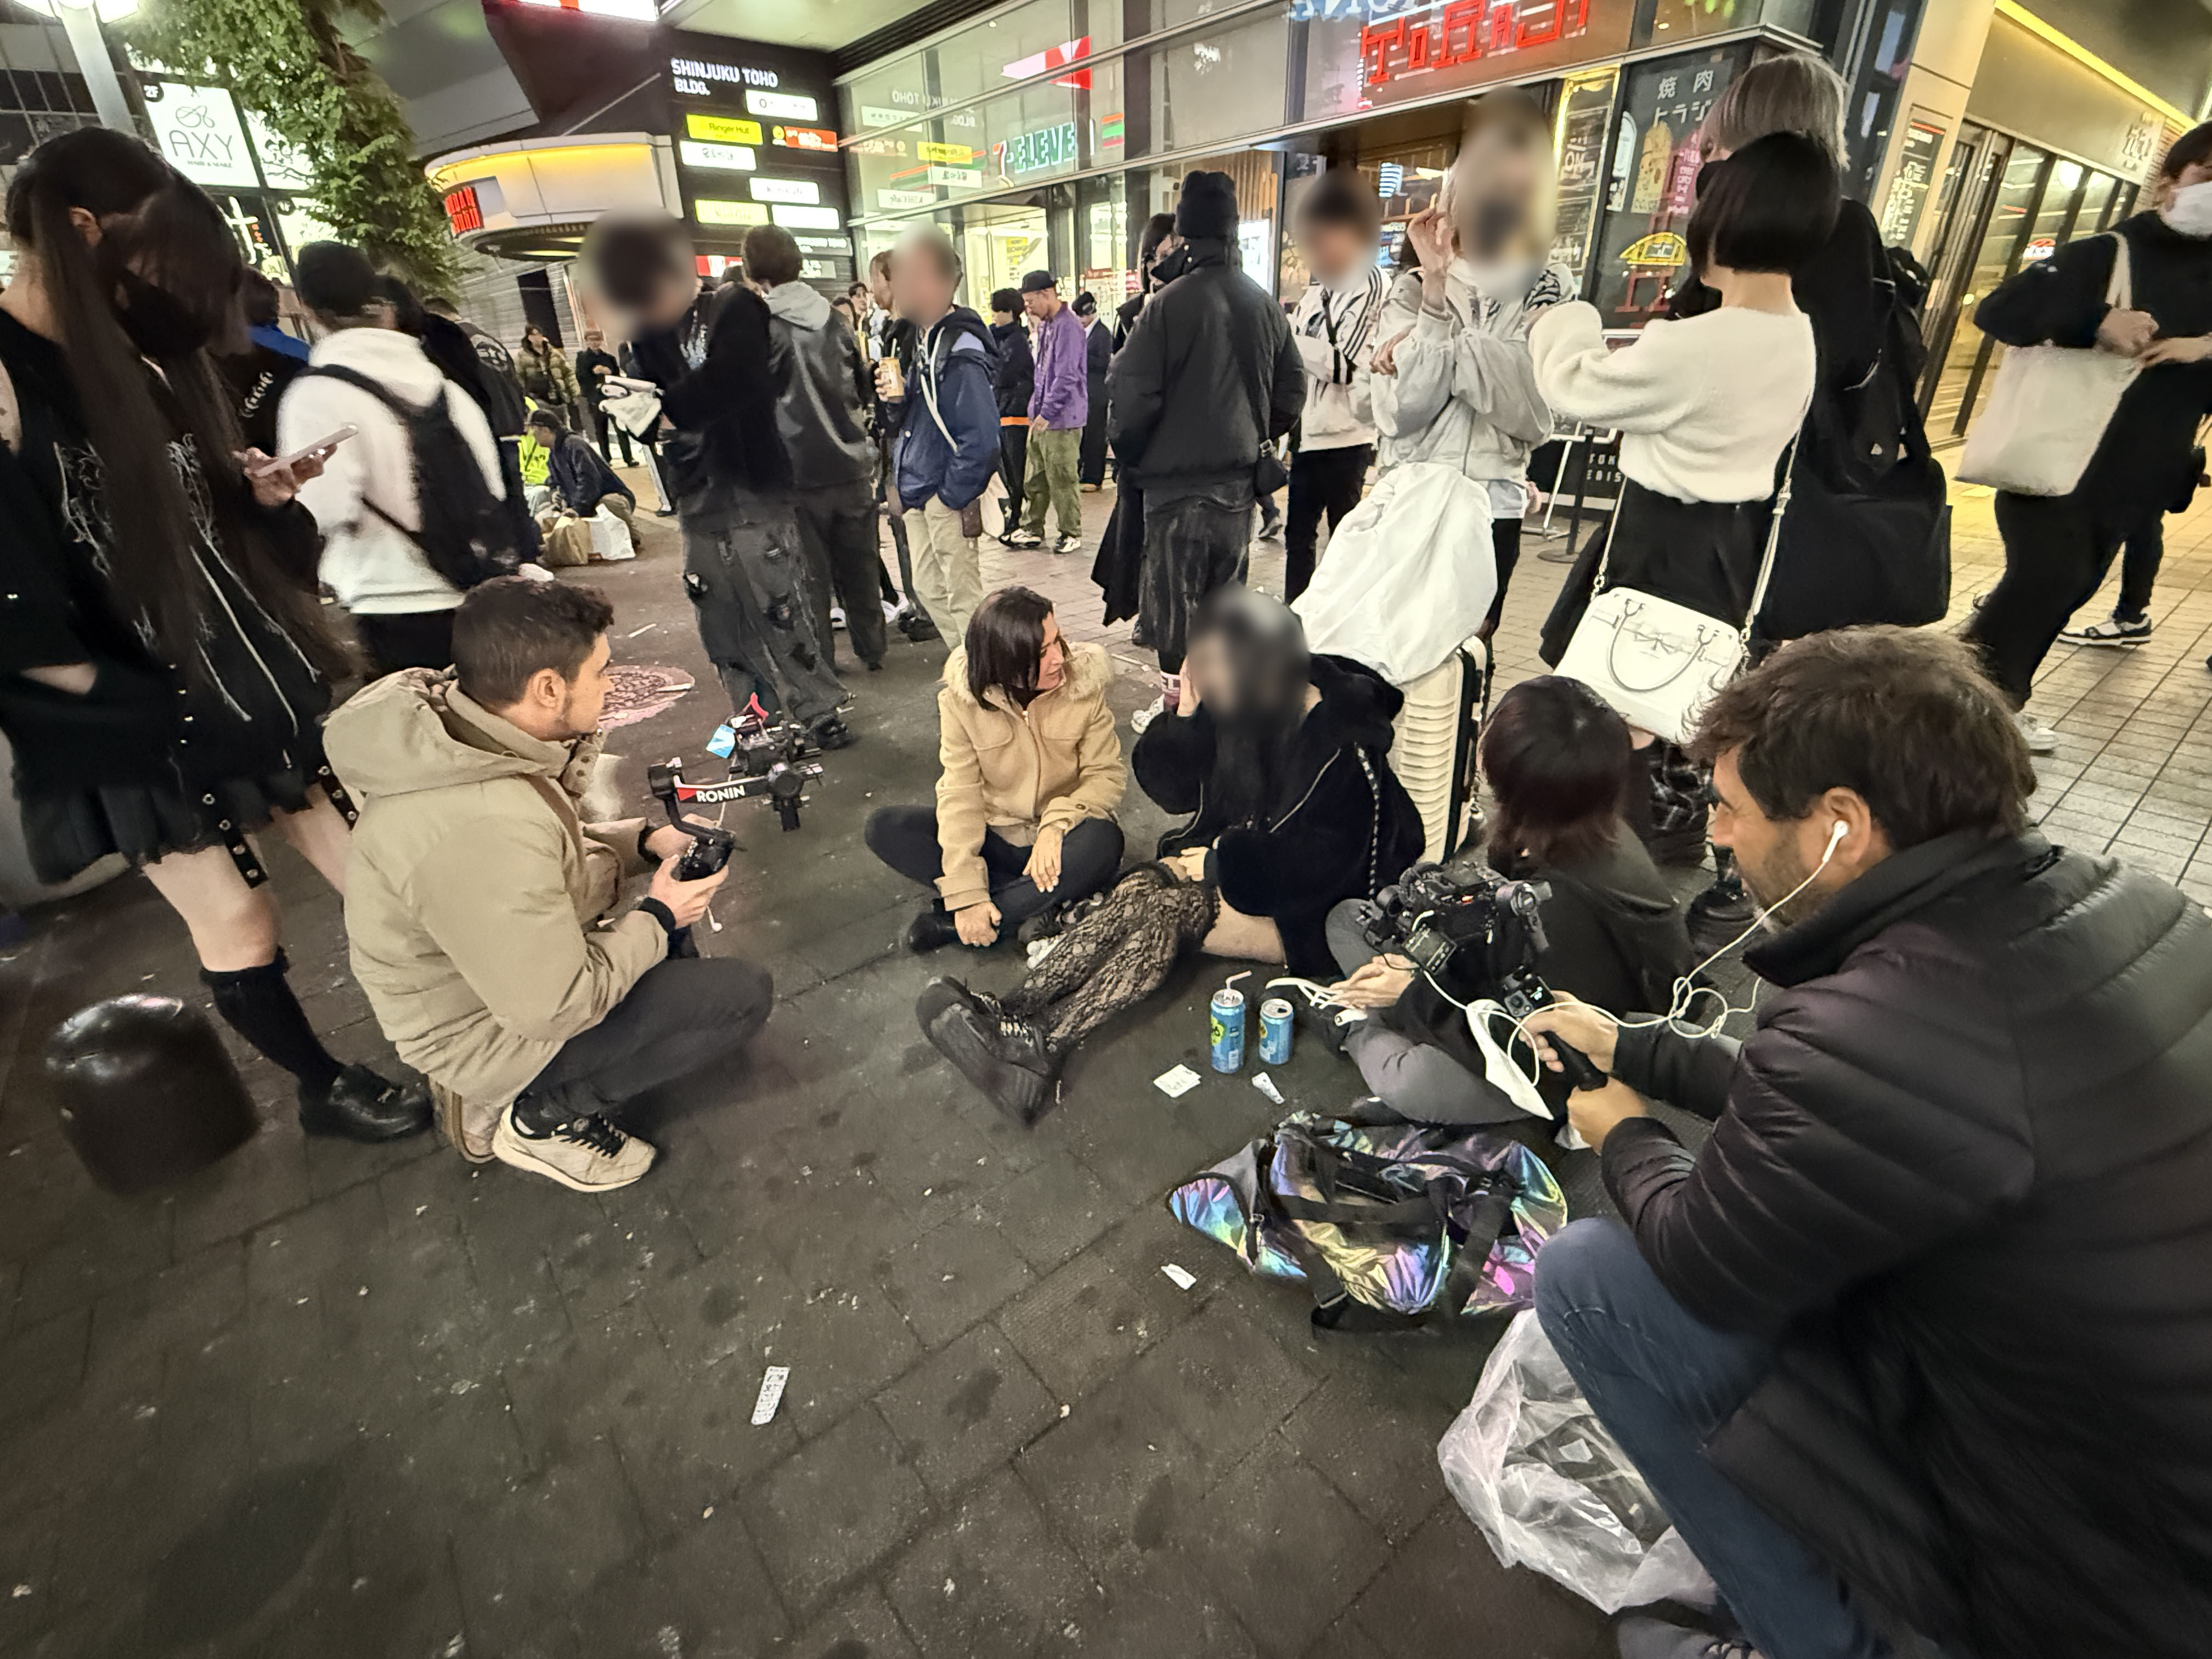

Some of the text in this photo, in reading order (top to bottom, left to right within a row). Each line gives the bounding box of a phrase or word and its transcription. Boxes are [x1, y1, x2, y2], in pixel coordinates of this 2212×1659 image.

[670, 57, 778, 88] SHINJUKU TOHO
[674, 77, 711, 95] BLDG.
[1656, 69, 1714, 100] 焼肉
[143, 85, 158, 98] 2F
[1653, 99, 1712, 127] トラジ
[169, 130, 232, 161] AXY
[696, 786, 746, 803] RONIN
